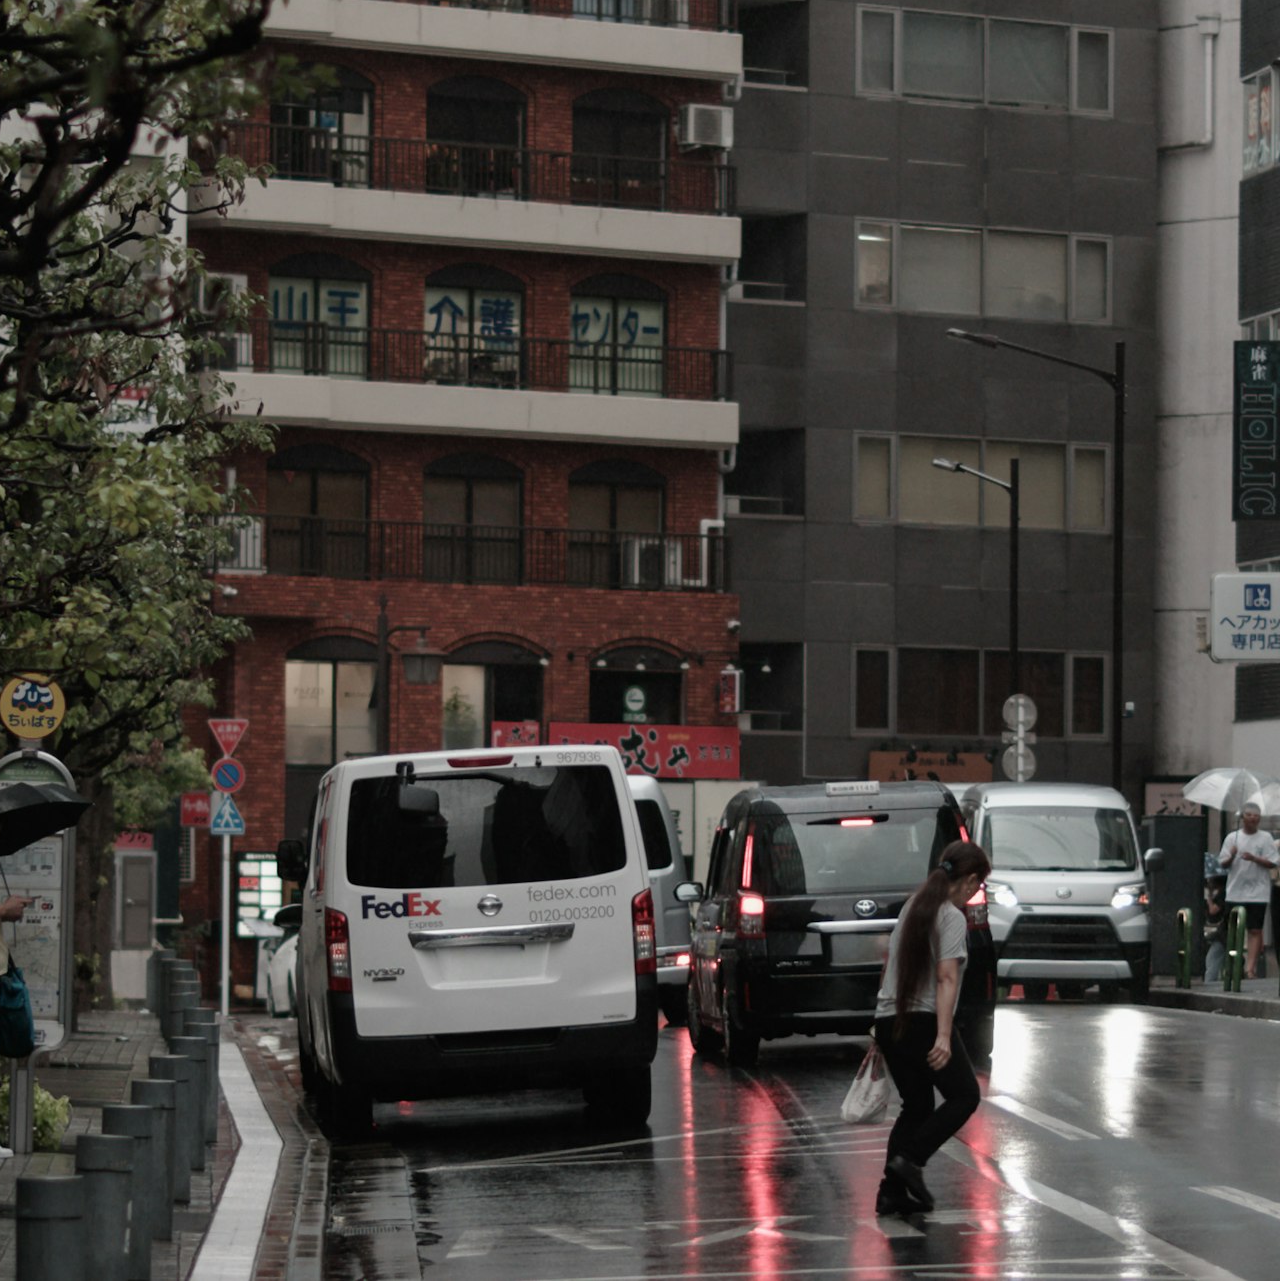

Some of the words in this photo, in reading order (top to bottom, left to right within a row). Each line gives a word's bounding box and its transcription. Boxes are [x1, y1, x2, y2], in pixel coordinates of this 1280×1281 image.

[1250, 345, 1269, 381] 麻雀
[556, 752, 602, 764] 967936
[527, 884, 617, 903] fedex.com
[361, 892, 442, 920] FedEx
[528, 905, 615, 923] 0120-003200
[408, 919, 444, 930] Express
[363, 968, 406, 978] NV350
